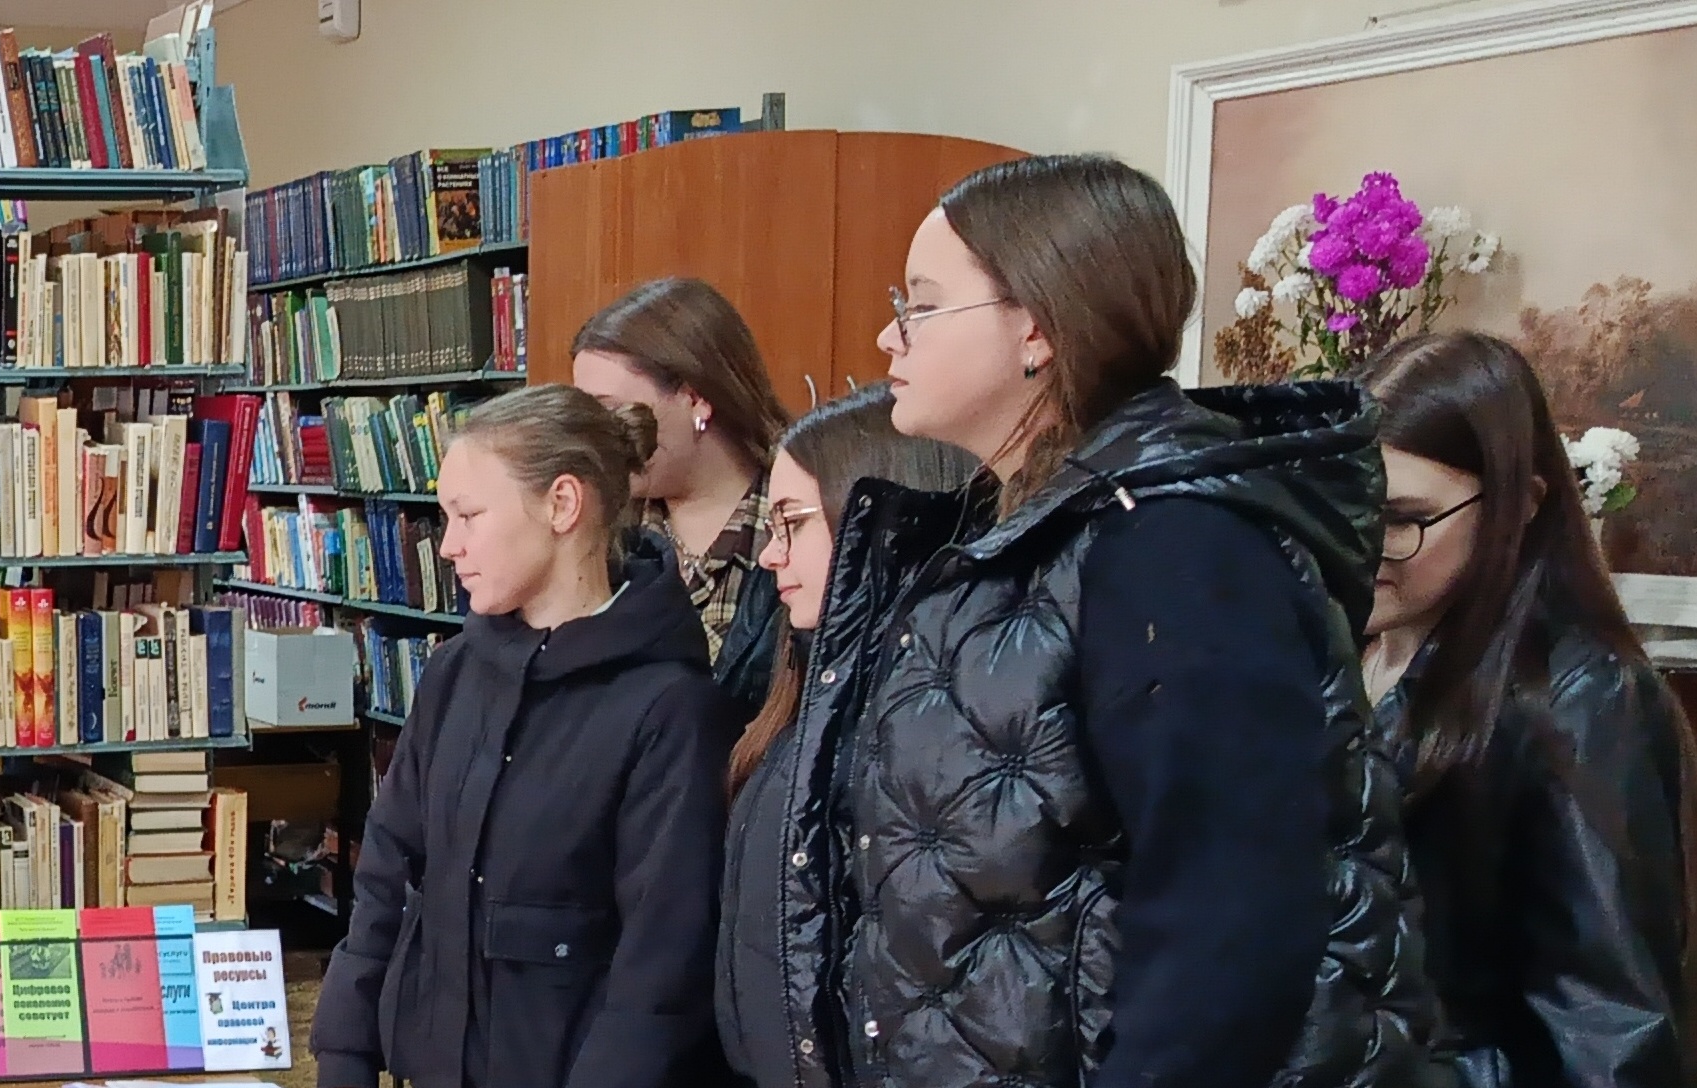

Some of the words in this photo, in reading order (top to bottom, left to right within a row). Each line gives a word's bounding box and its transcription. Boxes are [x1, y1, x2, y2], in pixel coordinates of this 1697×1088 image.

[305, 701, 337, 710] mondi
[202, 951, 272, 964] Правовые
[213, 969, 267, 983] ресурсы
[12, 985, 70, 997] Цифровое
[14, 1000, 71, 1009] поколение
[232, 999, 276, 1011] Центра
[19, 1012, 70, 1021] советует
[217, 1016, 264, 1027] правовой
[207, 1036, 258, 1046] информации
